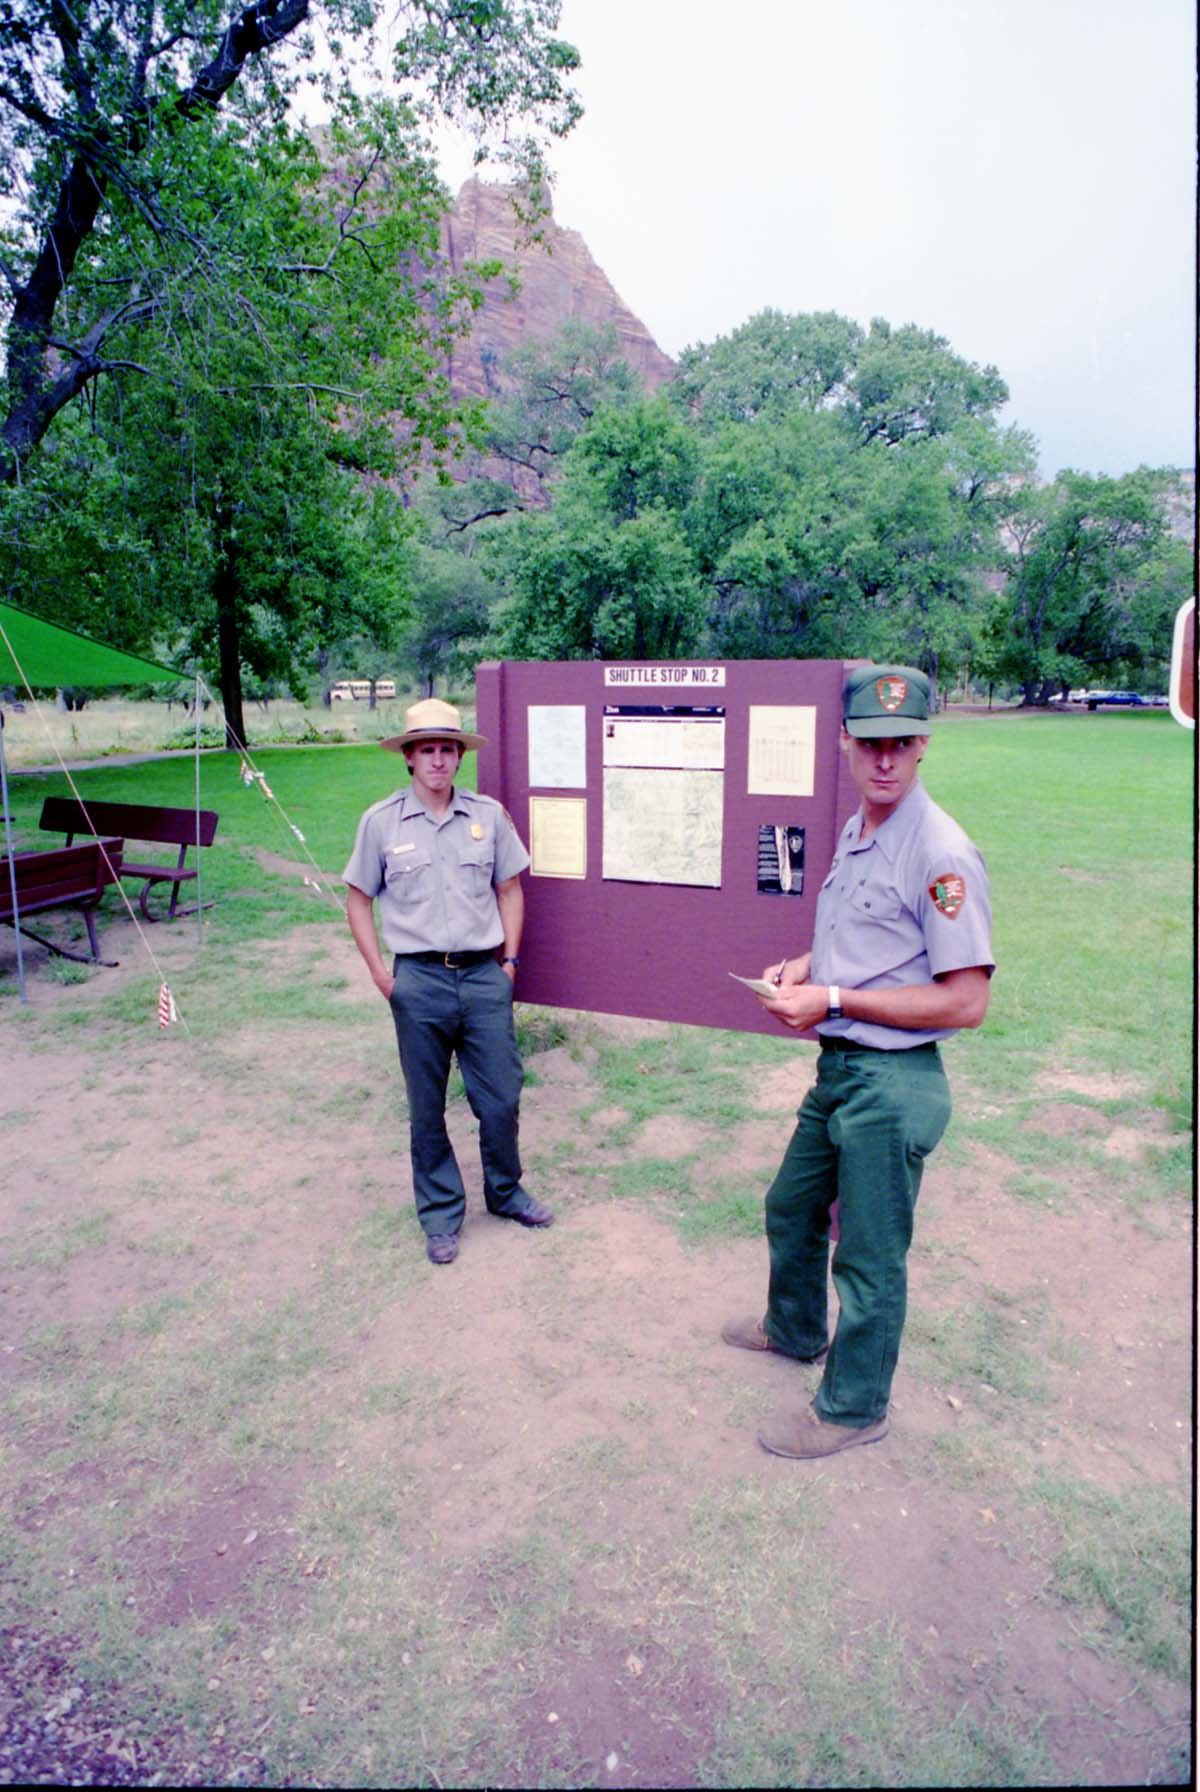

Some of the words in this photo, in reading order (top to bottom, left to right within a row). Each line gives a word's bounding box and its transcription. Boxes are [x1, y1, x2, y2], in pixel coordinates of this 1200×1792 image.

[609, 669, 657, 682] SHUTTLE
[660, 669, 688, 682] STOP
[692, 669, 709, 682] NO.
[711, 669, 719, 682] 2
